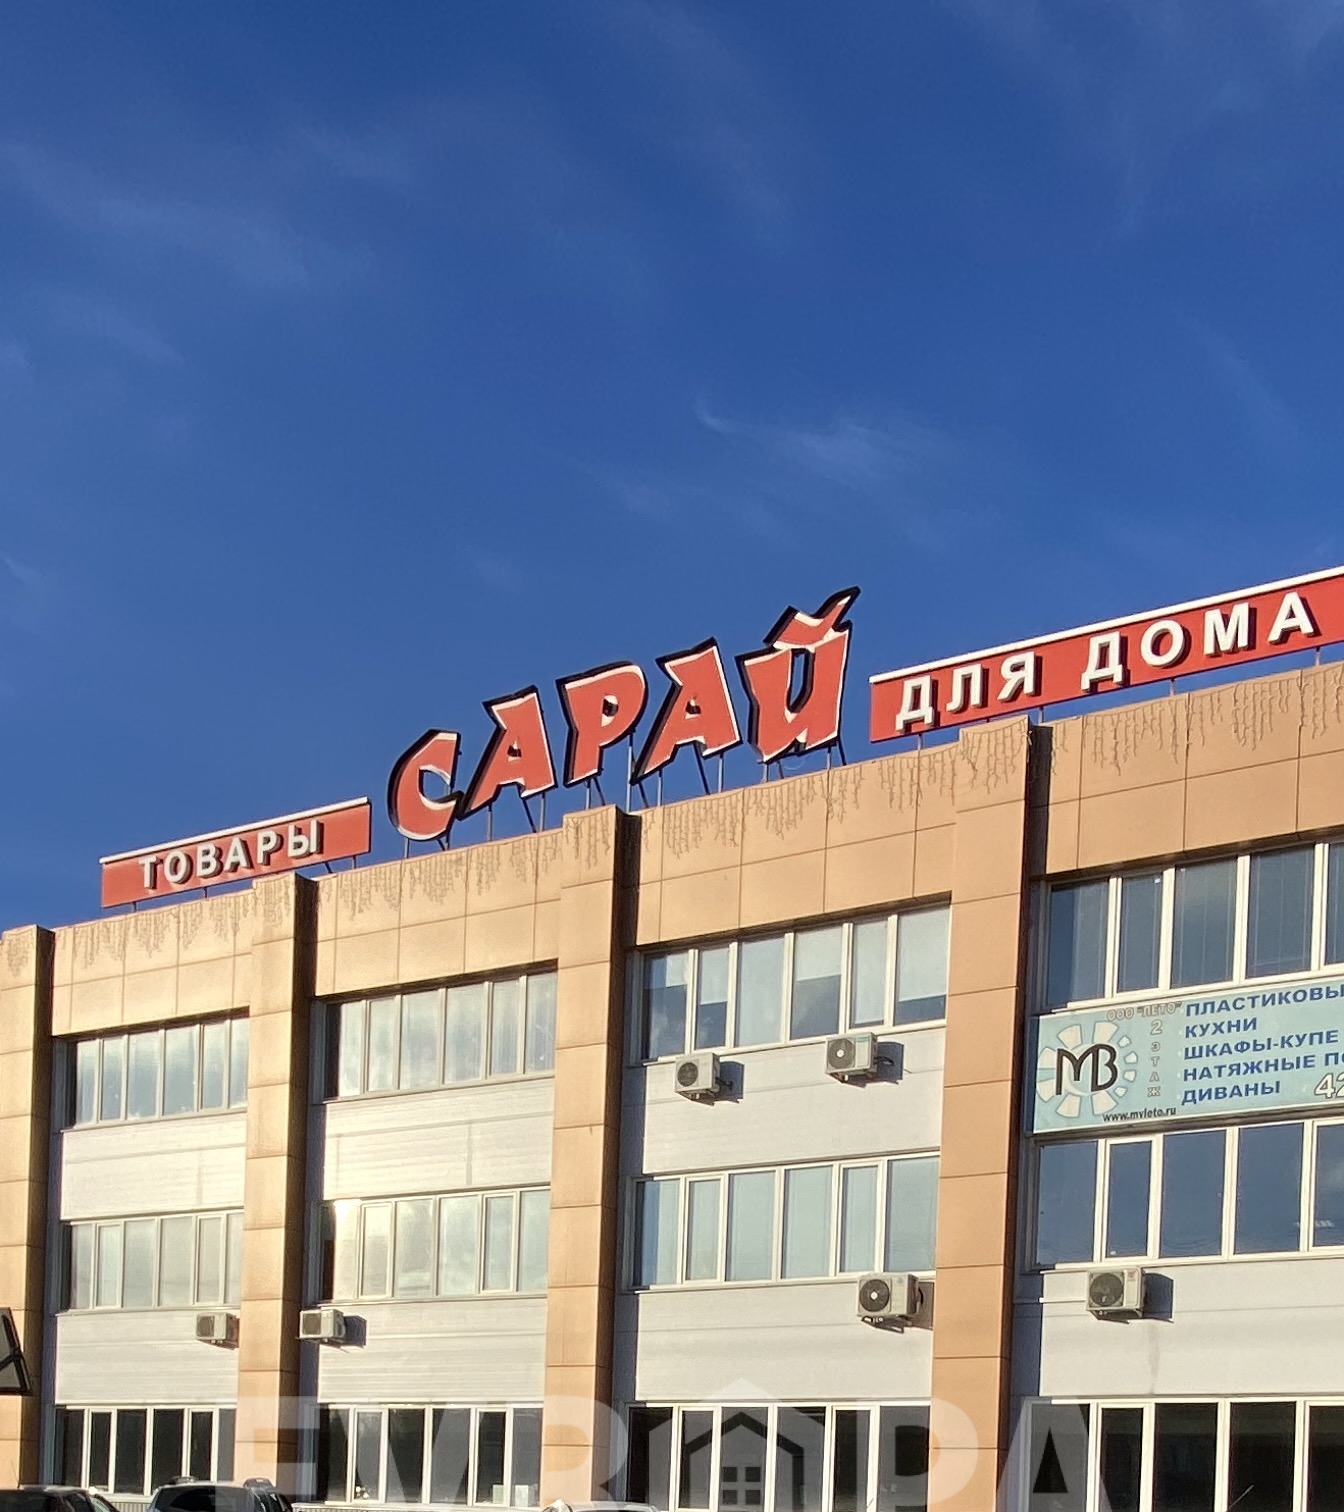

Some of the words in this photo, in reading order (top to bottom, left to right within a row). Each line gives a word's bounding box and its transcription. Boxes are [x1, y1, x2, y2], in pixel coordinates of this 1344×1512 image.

[895, 651, 1039, 731] ДЛЯ
[1081, 592, 1317, 691] ДОМА
[388, 586, 860, 841] САРАЙ
[139, 819, 323, 889] ТОВАРЫ
[1107, 1007, 1135, 1021] ООО
[1150, 1019, 1163, 1036] 2
[1184, 1017, 1258, 1039] КУХНИ
[1183, 1029, 1339, 1060] ШКАФЫ-КУПЕ
[1183, 1054, 1316, 1082] НАТЯЖНЫЕ
[1181, 1080, 1281, 1105] ДИВАНЫ
